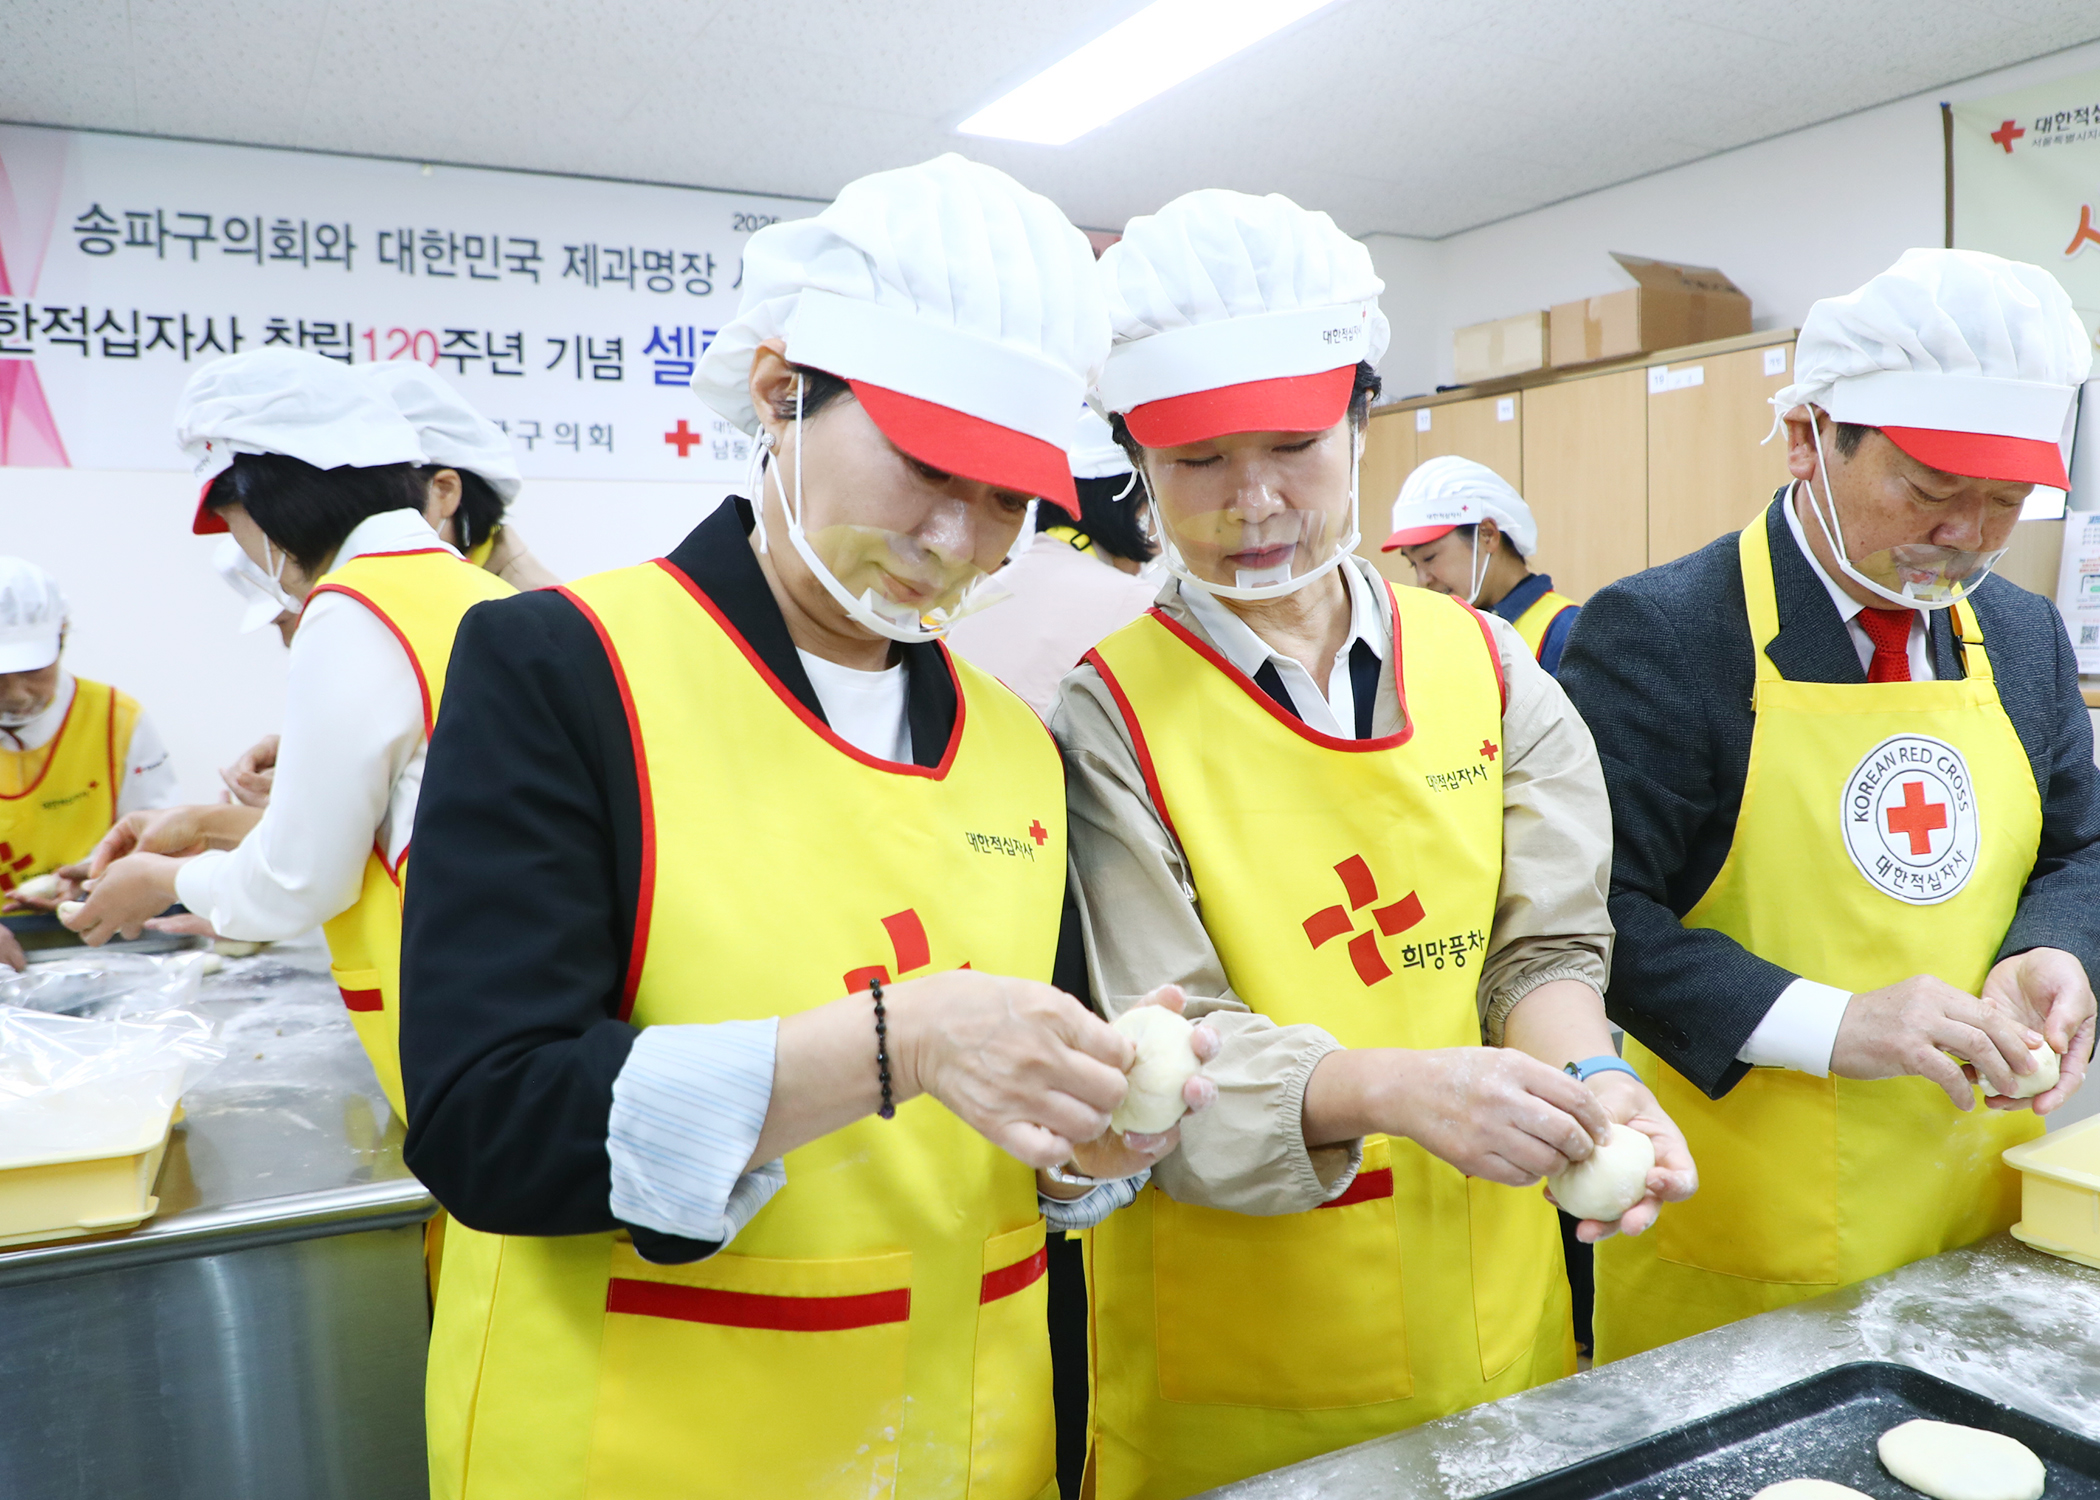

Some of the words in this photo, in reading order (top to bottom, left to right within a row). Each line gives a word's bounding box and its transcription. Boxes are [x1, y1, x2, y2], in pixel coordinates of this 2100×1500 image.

[73, 203, 357, 271] 송파구의회와
[378, 229, 544, 284] 대한민국
[562, 243, 717, 295] 제과명장
[546, 334, 624, 381] 기념
[496, 419, 614, 452] 구의회
[1425, 763, 1488, 792] 대적십자사
[1854, 752, 1897, 822] KOREAN
[1899, 747, 1932, 763] RED
[1937, 756, 1969, 812] CROSS
[965, 831, 1035, 862] 대한적십자사
[1875, 850, 1967, 893] 대한적십자사
[1401, 929, 1486, 970] 희망풍차
